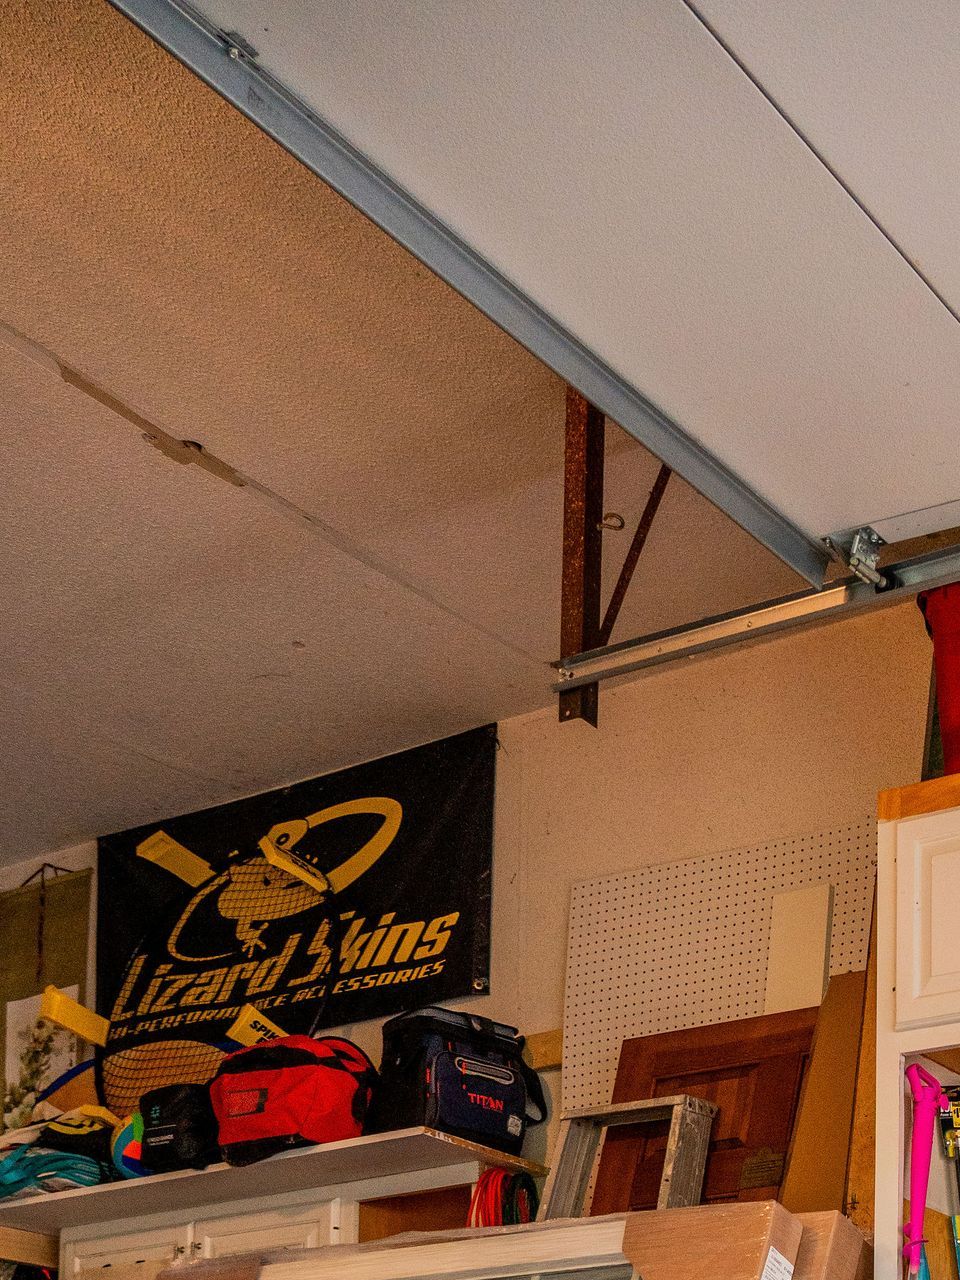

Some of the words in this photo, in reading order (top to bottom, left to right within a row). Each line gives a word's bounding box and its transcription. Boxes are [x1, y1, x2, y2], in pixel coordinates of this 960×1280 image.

[110, 933, 302, 1022] Lizard
[287, 911, 460, 987] Skins
[467, 1092, 504, 1111] TITAN
